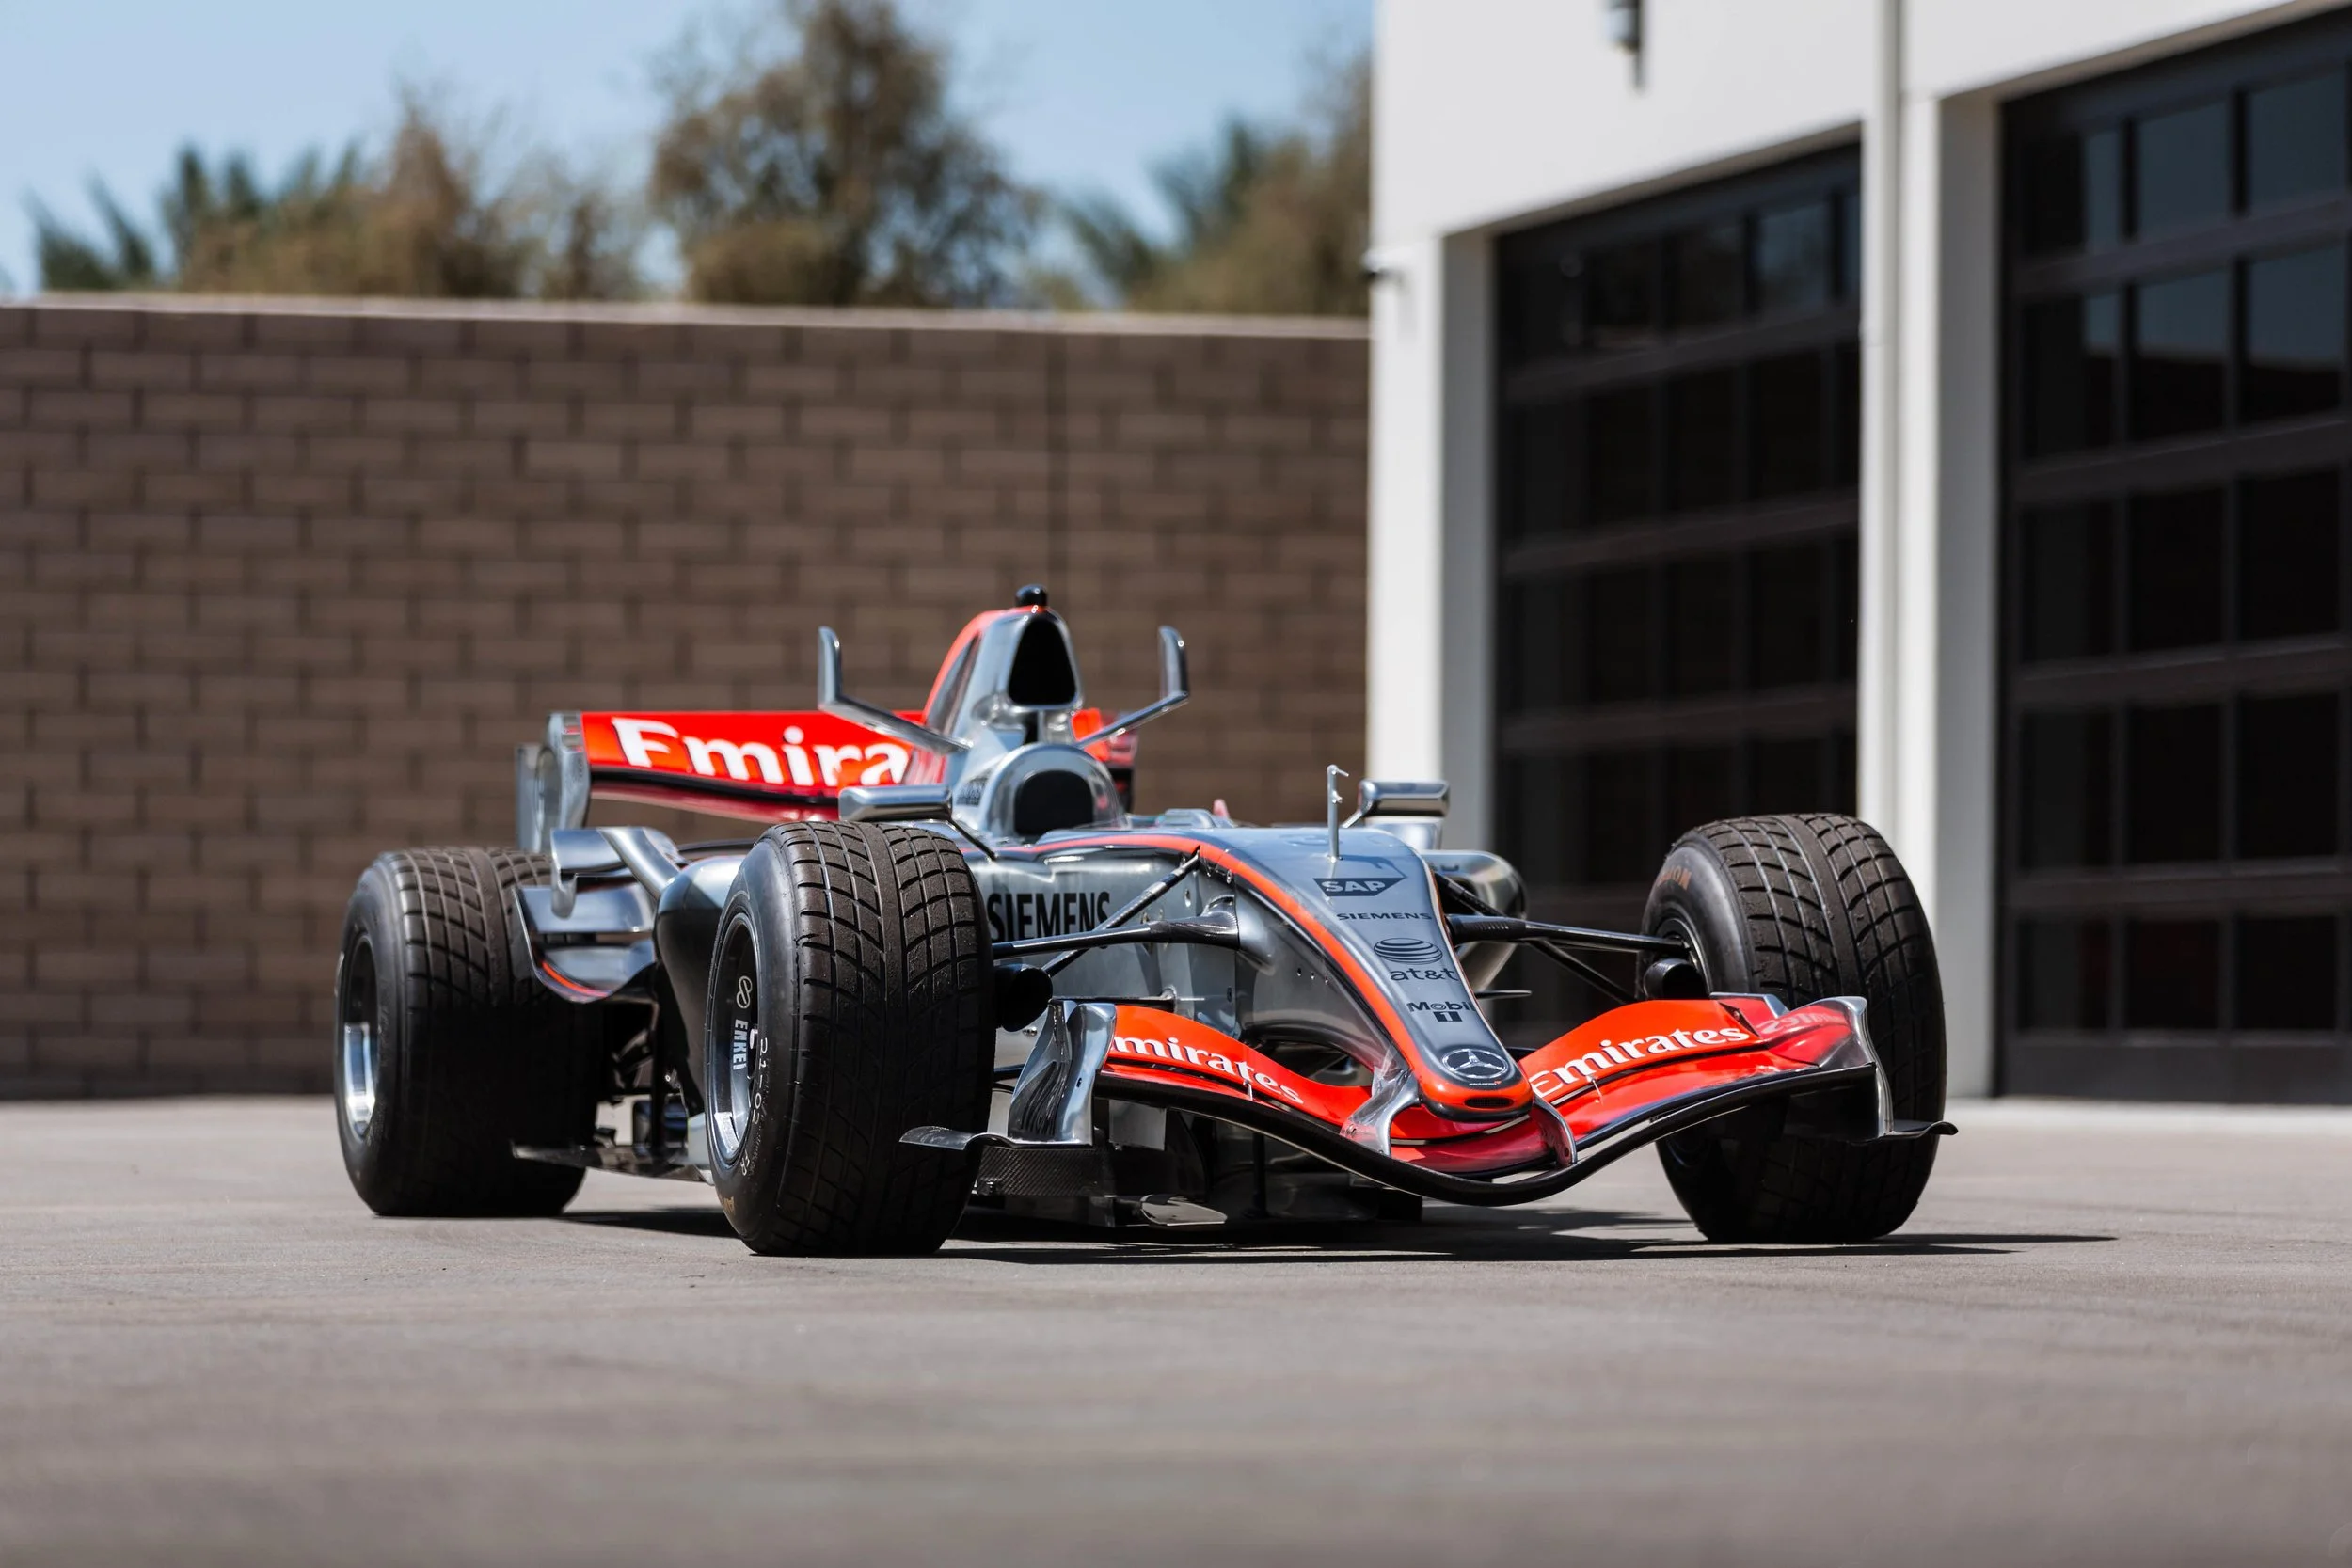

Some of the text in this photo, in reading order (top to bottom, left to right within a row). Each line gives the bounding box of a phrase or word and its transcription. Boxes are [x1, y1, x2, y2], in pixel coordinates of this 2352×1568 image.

[612, 717, 911, 786] Emira
[1321, 880, 1386, 893] SAP
[987, 891, 1110, 942] SIEMENS
[1336, 912, 1432, 921] SIEMENS
[1390, 968, 1459, 981] at&t
[1406, 1001, 1476, 1012] Mobil
[733, 1019, 749, 1070] ENKEI
[1529, 1027, 1750, 1099] Emirates
[1111, 1037, 1305, 1104] mirates
